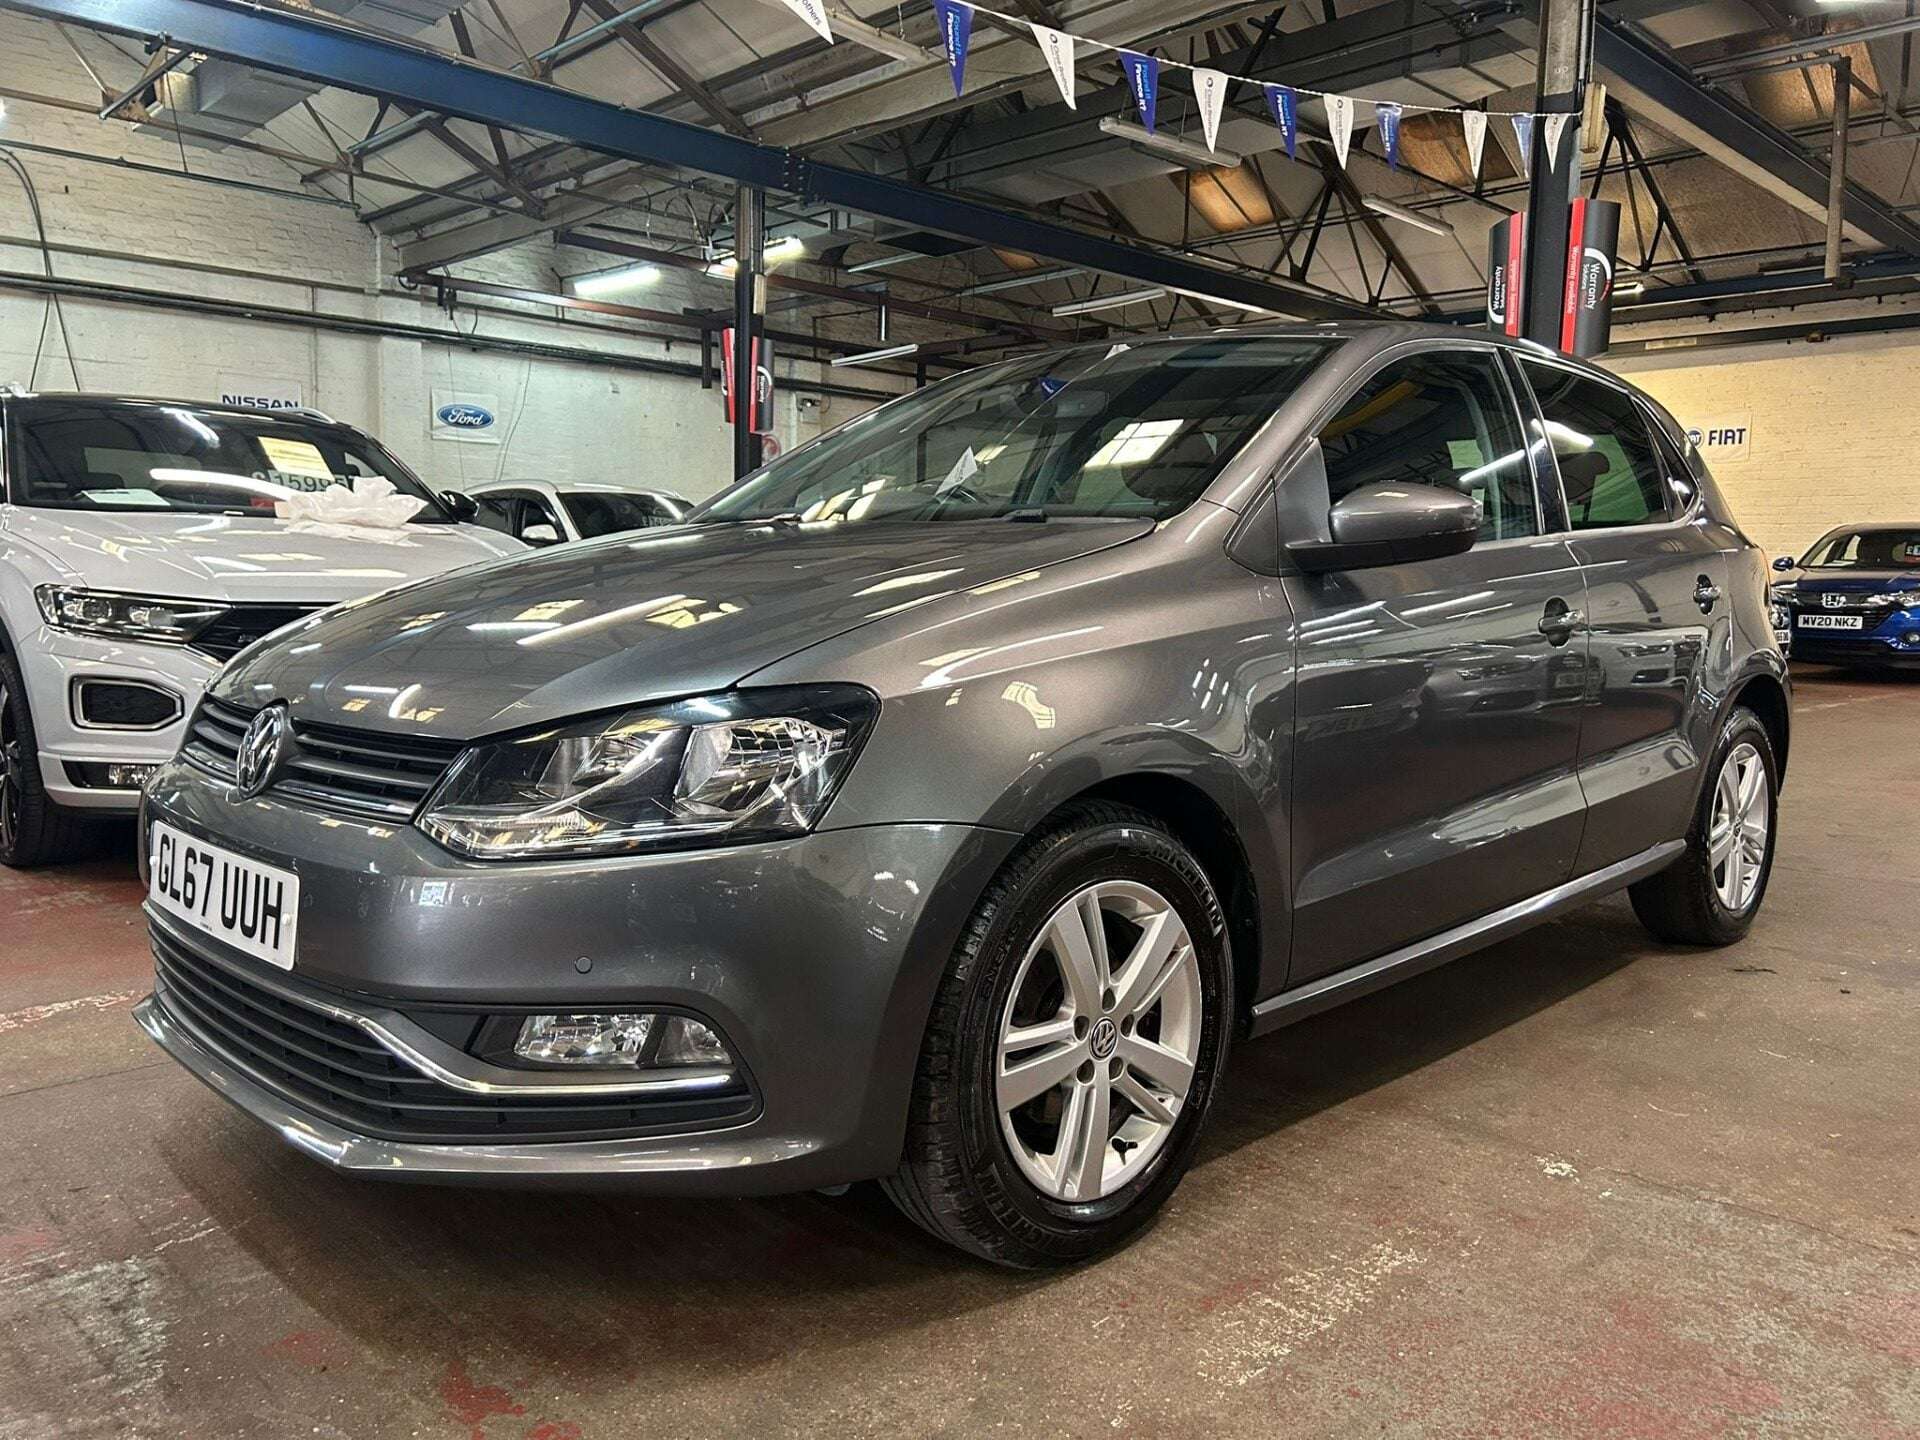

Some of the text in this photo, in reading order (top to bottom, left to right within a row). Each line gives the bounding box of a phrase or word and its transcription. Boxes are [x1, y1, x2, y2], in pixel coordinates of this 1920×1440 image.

[946, 11, 957, 67] Finance it?
[953, 14, 961, 46] Found
[1134, 63, 1148, 112] Finance it?
[1141, 64, 1150, 92] Found
[1276, 94, 1285, 125] Finance
[1492, 266, 1503, 310] Warranty
[1581, 263, 1590, 290] Solutions
[1585, 262, 1600, 310] Warranty
[222, 394, 299, 410] NISSAN
[447, 407, 485, 425] Ford
[1708, 427, 1747, 447] FIAT
[1834, 617, 1858, 628] NKZ
[158, 833, 284, 951] GL67 UUH
